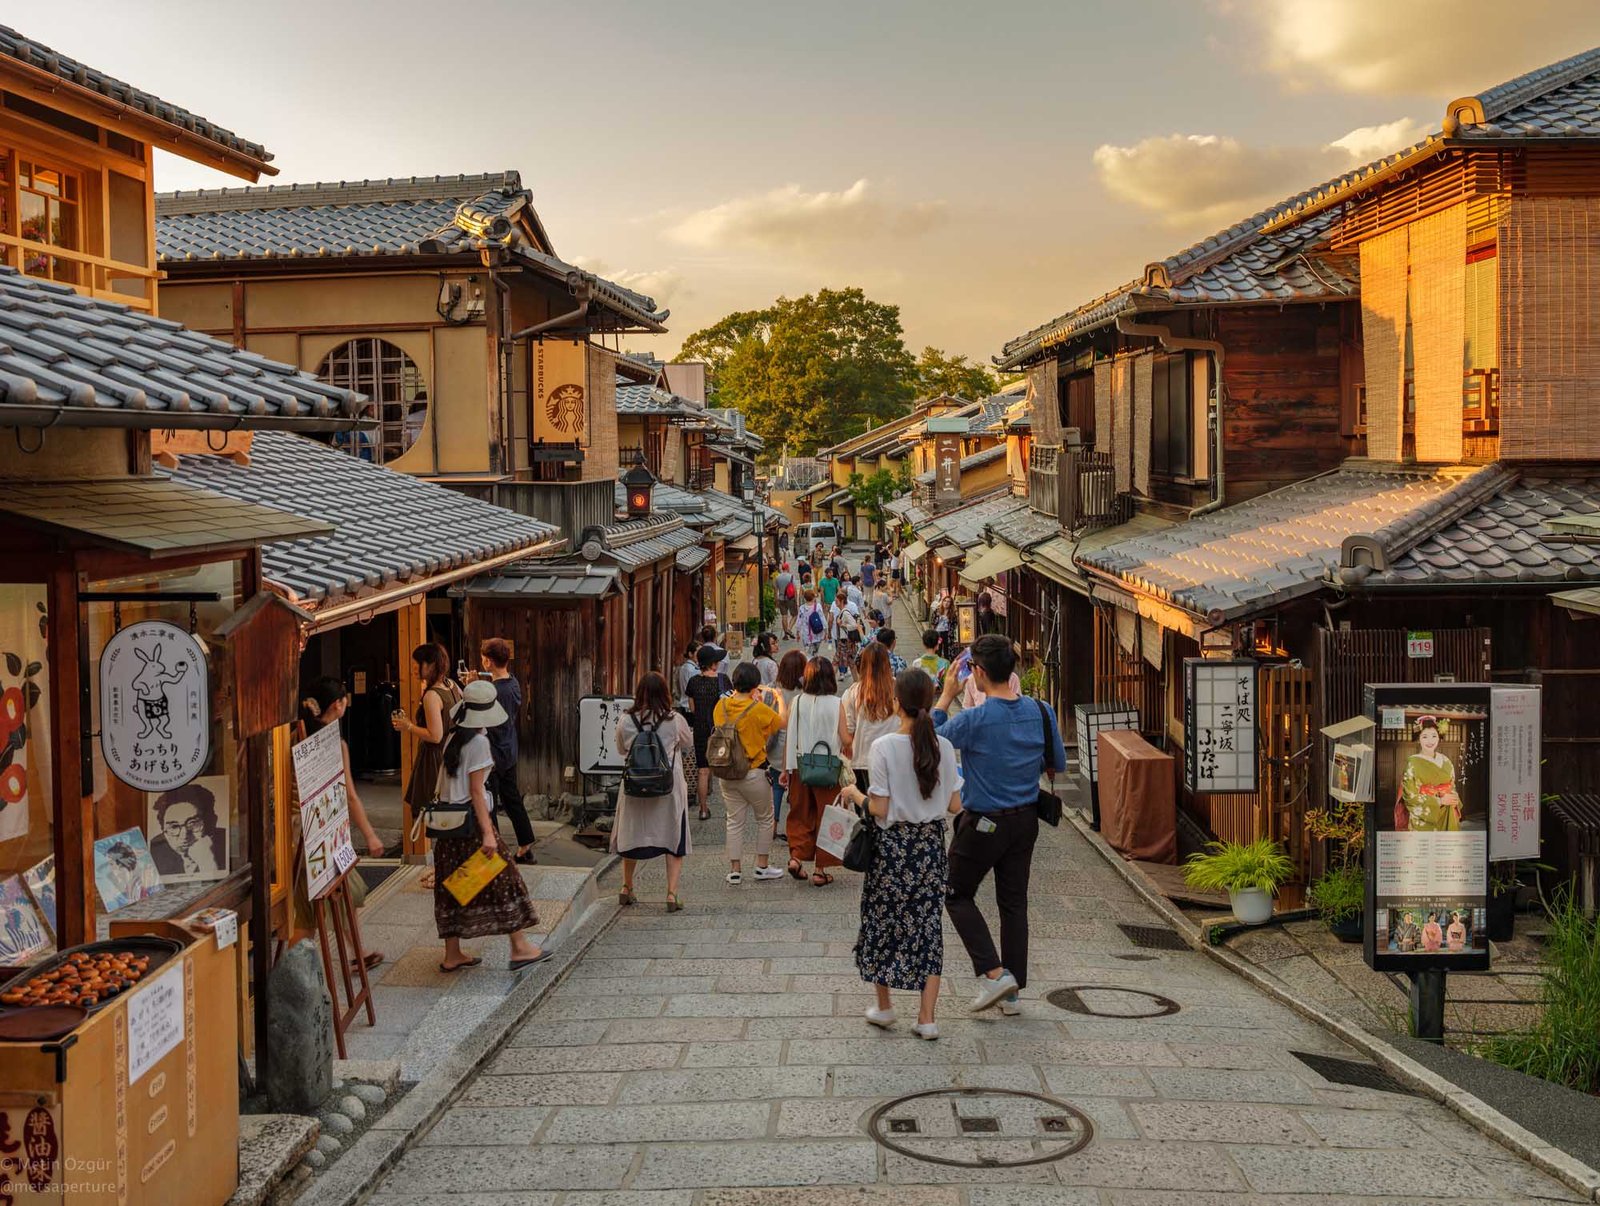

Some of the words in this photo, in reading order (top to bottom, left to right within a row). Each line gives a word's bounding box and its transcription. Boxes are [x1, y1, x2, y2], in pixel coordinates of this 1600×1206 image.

[537, 348, 545, 399] STARBUCKS
[1410, 640, 1432, 653] 119
[1236, 676, 1251, 723] そば処
[1218, 705, 1234, 752] 二寧坂
[132, 742, 178, 757] もっちり
[1198, 728, 1220, 780] ふたば
[129, 757, 183, 774] あげもち
[1496, 793, 1507, 817] 50%
[1496, 817, 1507, 833] off
